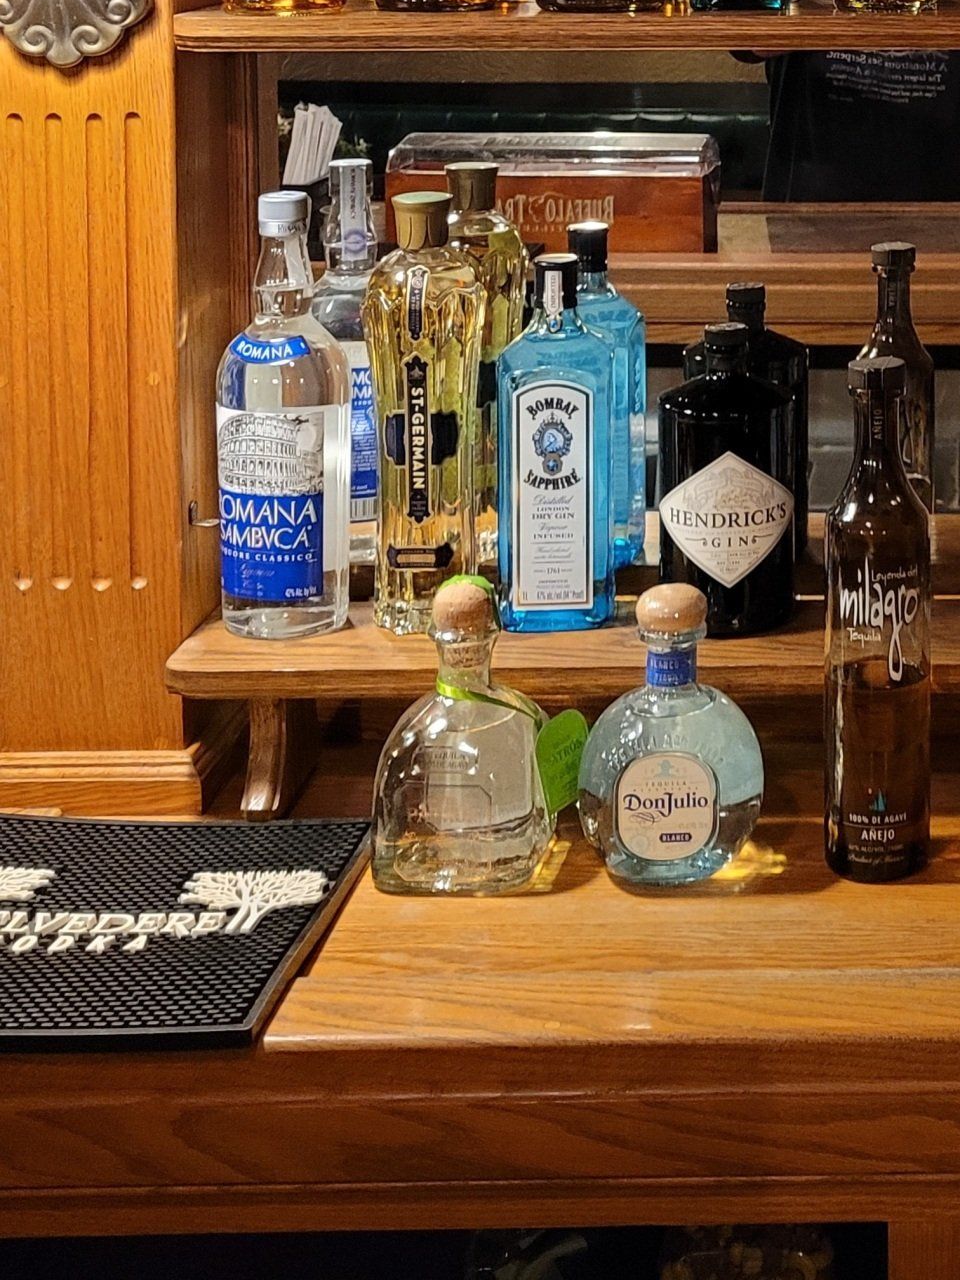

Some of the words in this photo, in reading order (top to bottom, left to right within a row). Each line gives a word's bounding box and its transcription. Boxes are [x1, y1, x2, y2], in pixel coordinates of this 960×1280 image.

[237, 340, 293, 360] ROMANA
[525, 397, 580, 420] BOMBAY
[410, 386, 425, 491] ST-GERMAIN
[524, 468, 581, 491] SAPPHIRE
[532, 494, 574, 506] Distilled
[219, 495, 317, 526] OMANA
[555, 512, 575, 520] GIN
[670, 502, 787, 529] HENDRICK'S
[711, 535, 749, 548] GIN
[255, 553, 312, 563] CLASSICO
[839, 554, 918, 682] milagro
[847, 628, 881, 648] Tequila
[650, 658, 679, 669] BLANCO
[849, 812, 869, 824] 100%
[872, 816, 881, 825] DE
[884, 811, 907, 824] AGAVE
[661, 833, 690, 842] BLANCO
[861, 826, 895, 843] AÑEJO
[0, 935, 148, 954] ODKA
